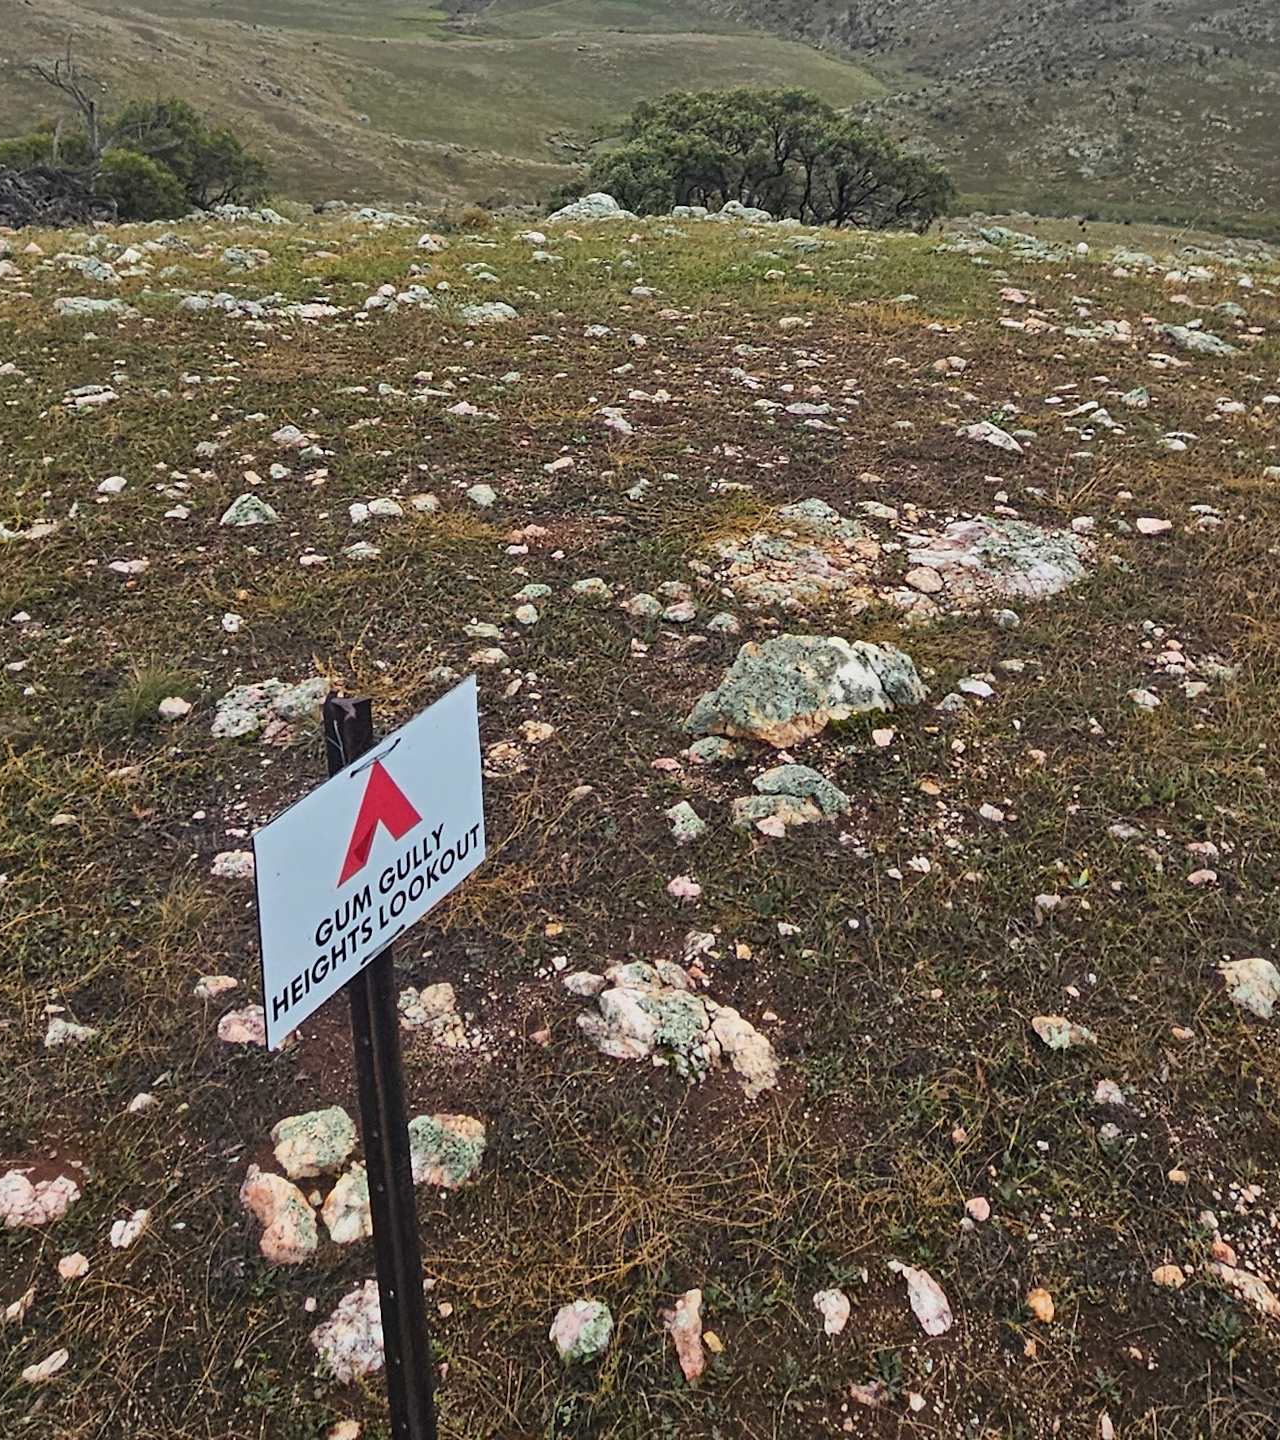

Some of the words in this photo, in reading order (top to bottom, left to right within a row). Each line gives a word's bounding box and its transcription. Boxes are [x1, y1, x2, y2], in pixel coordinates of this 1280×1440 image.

[272, 925, 373, 1023] HEIGHTS
[378, 824, 481, 929] LOOKOUT
[315, 884, 373, 947] GUM
[378, 823, 445, 895] GULLY
